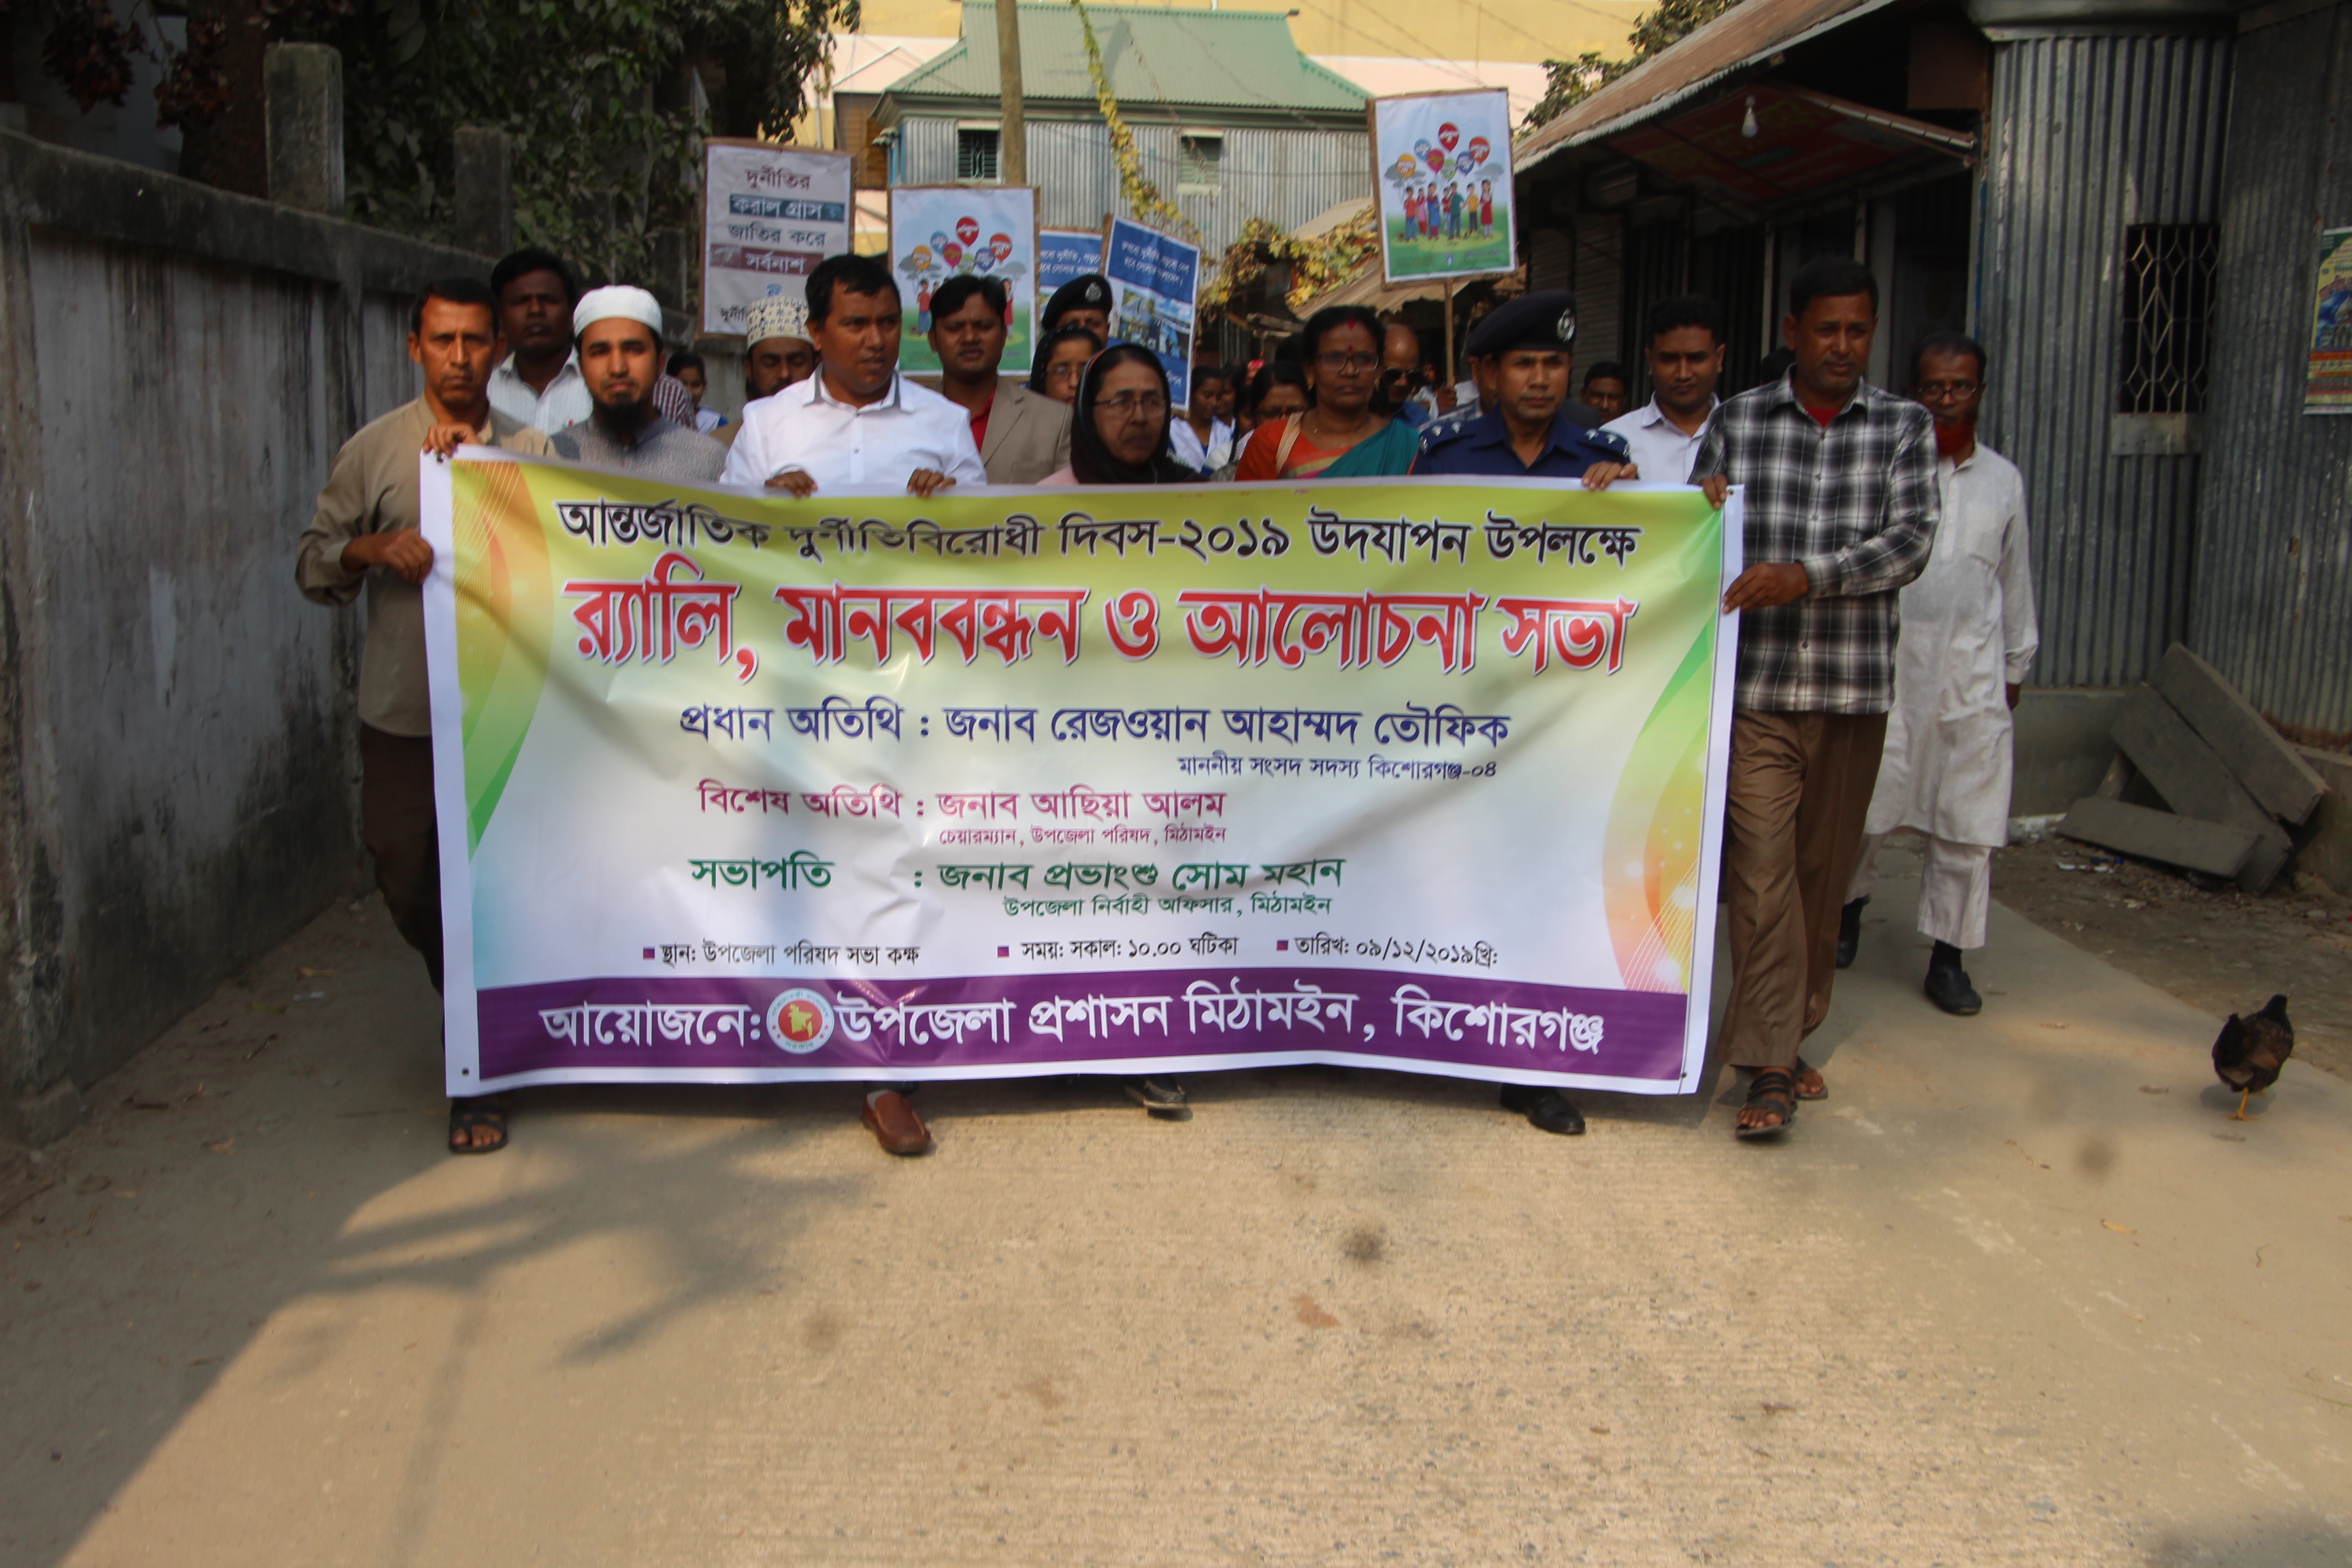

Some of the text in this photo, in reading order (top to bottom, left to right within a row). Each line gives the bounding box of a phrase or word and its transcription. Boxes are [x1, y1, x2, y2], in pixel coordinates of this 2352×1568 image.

[745, 166, 811, 191] দুর্নীতির
[732, 196, 782, 218] করাল
[727, 220, 827, 248] জাতির করে
[745, 250, 806, 274] সর্বনাশ
[554, 497, 1642, 568] আন্তর্জাতিক দুর্নীতিবিরোধী দিবস-২০১৯ উদযাপন উপলক্ষে
[775, 580, 1090, 667] মানববন্ধন
[1105, 588, 1159, 662] ও
[1177, 586, 1488, 674] আলোচনা
[1496, 595, 1639, 676] সভা
[681, 704, 775, 742] প্রধান
[787, 696, 904, 743] অতিথি
[943, 705, 1039, 743] জনাব
[1051, 705, 1210, 744] রেজওয়ান
[1222, 706, 1363, 745] আহাম্মদ
[1375, 701, 1512, 748] তৌফিক
[1177, 750, 1497, 781] মাননীয় সংসদ সদস্য কিশোরগঞ্জ-০৪
[696, 777, 790, 815] বিশেষ
[800, 783, 903, 819] অতিথি
[936, 790, 1020, 819] জনাব
[1029, 783, 1132, 823] আছিয়া
[1141, 790, 1227, 819] আলম
[940, 822, 1227, 848] চেয়ারম্যান, উপজেলা পরিষদ, মিঠামইন
[688, 850, 835, 892] সভাপতি
[936, 860, 1034, 891] জনাব
[1044, 860, 1159, 892] প্রভাংশু
[1172, 860, 1250, 892] সোম
[1260, 858, 1347, 887] মহান
[1002, 892, 1333, 917] উপজেলা নির্বাহী অফিসার, মিঠামইন
[701, 937, 777, 966] উপজেলা
[783, 938, 841, 966] পরিষদ
[845, 945, 881, 966] সভা
[885, 946, 921, 966] কক্ষ
[1128, 938, 1182, 958] ১০.০০
[1188, 932, 1240, 958] ঘটিকা
[834, 990, 1017, 1045] উপজেলা
[1028, 994, 1173, 1043] প্রশাসন
[1182, 977, 1377, 1043] মিঠামইন,
[1391, 984, 1605, 1055] কিশোরগঞ্জ
